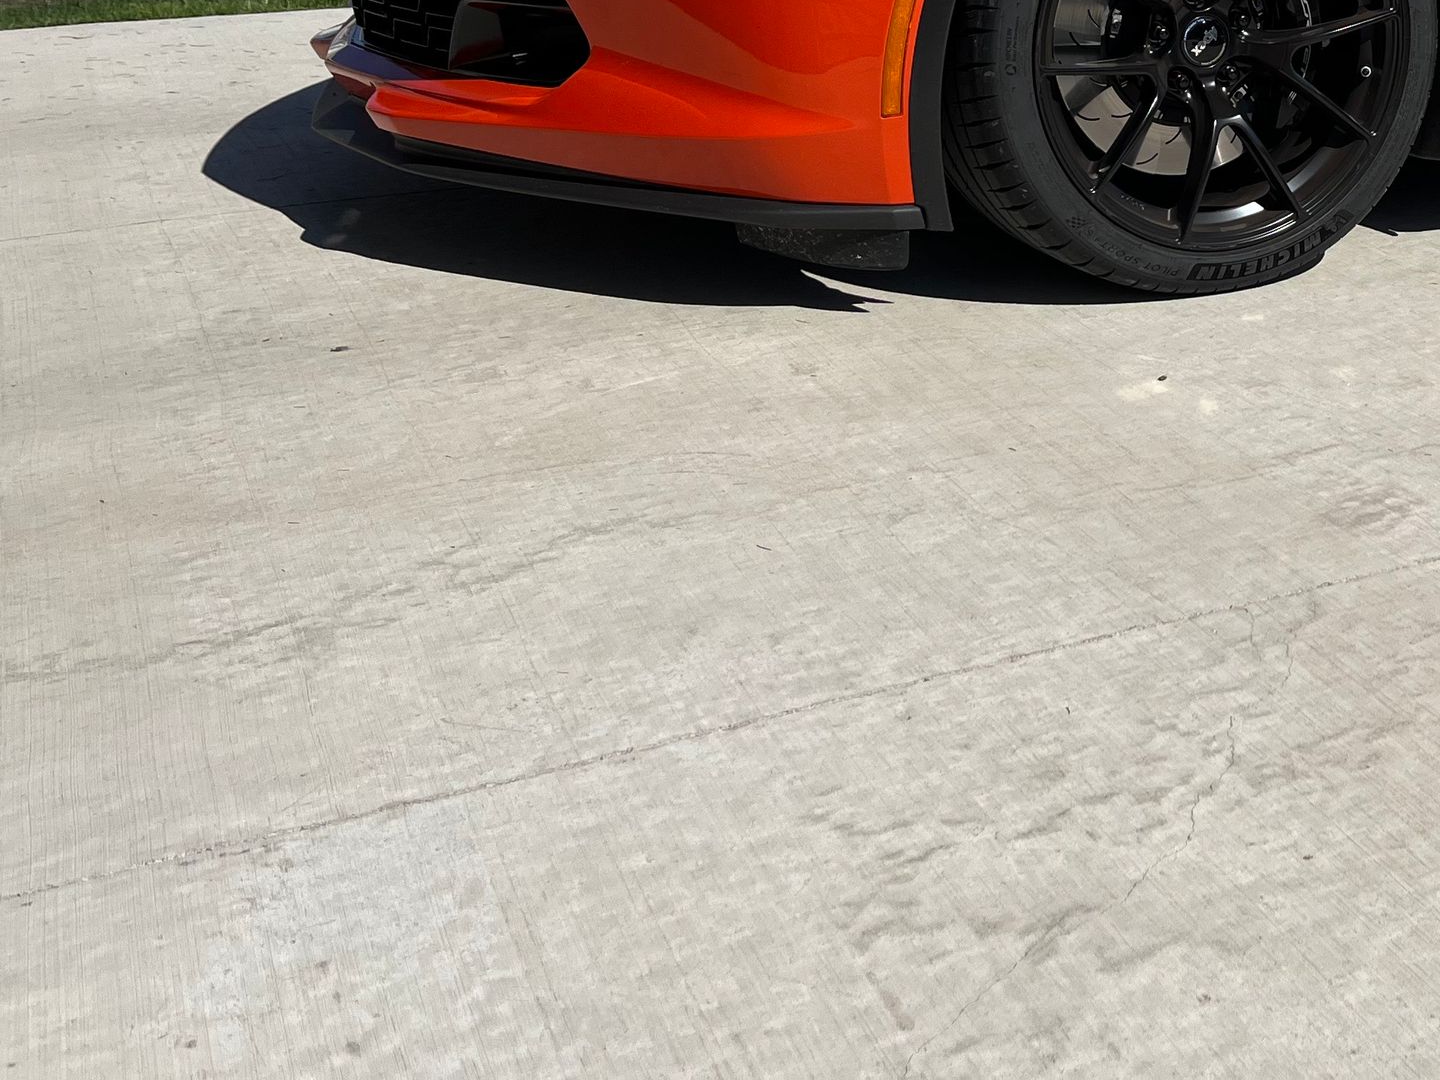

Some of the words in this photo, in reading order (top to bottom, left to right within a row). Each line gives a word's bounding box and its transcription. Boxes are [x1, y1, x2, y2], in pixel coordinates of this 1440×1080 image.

[1100, 241, 1139, 266] SPORT
[1197, 233, 1321, 280] MICHELIN
[1144, 262, 1179, 276] PILOT
